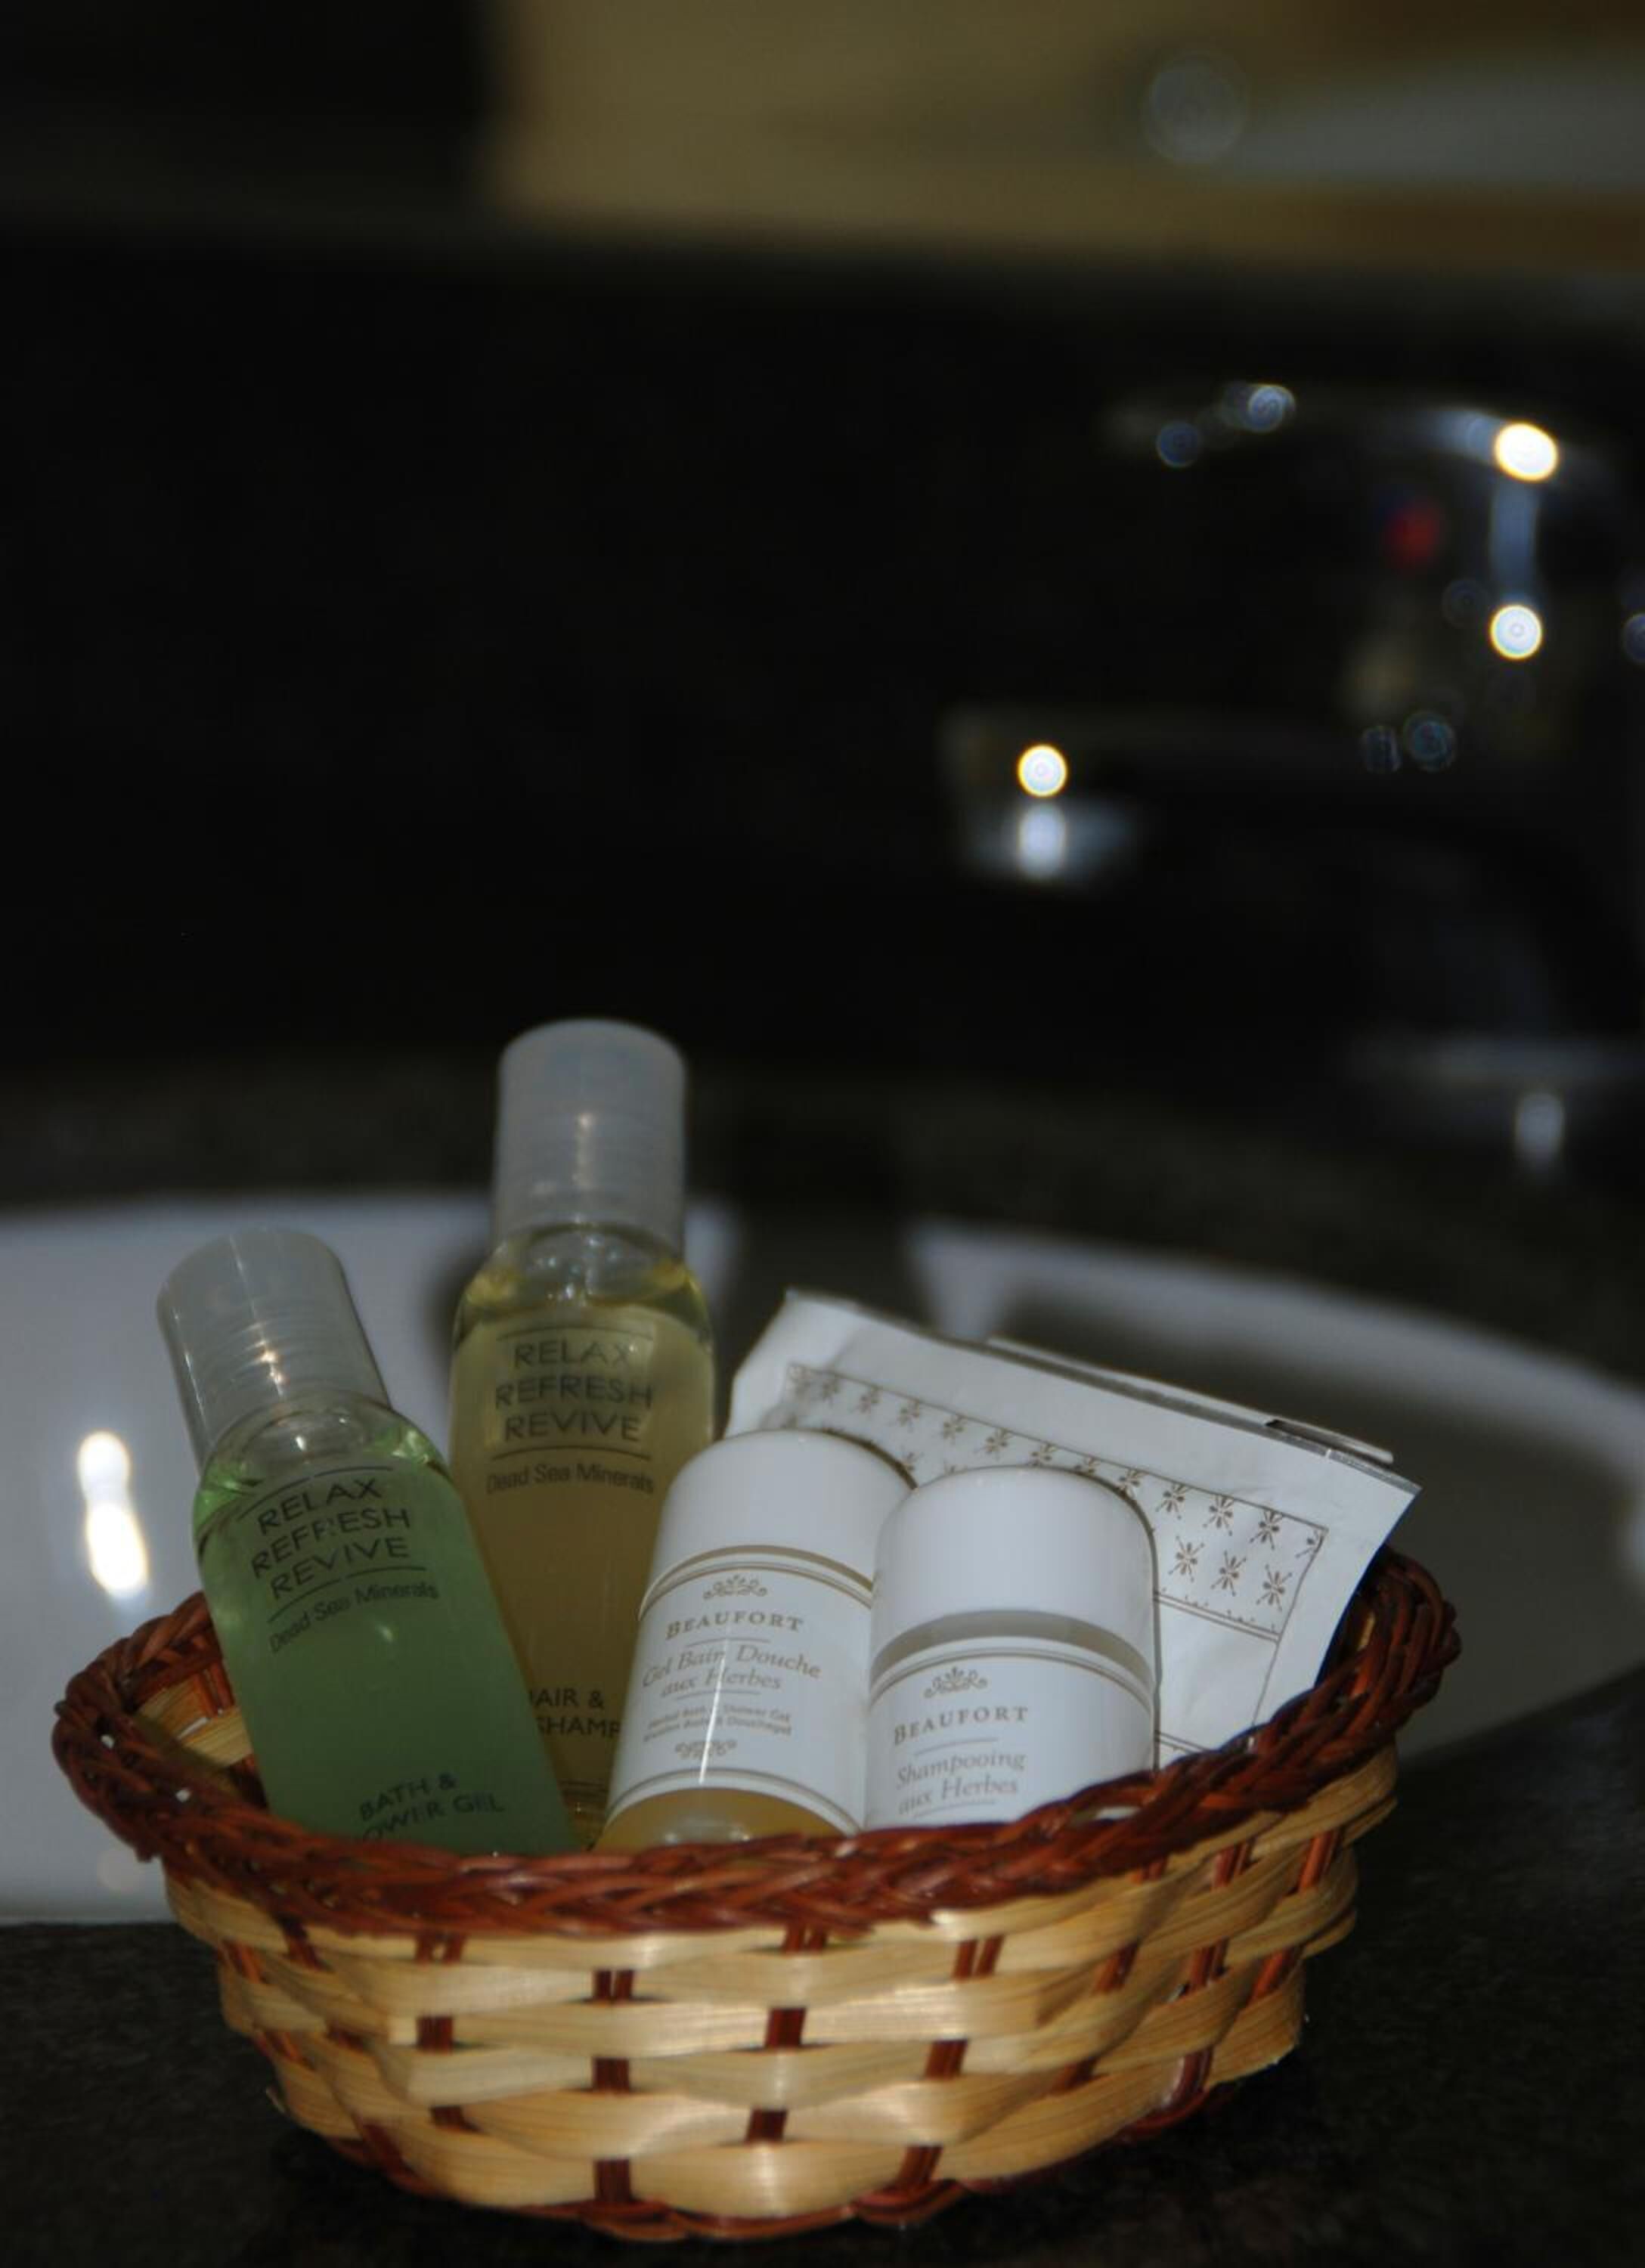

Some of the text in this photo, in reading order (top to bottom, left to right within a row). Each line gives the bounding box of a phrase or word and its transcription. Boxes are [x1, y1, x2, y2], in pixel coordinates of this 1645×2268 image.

[515, 1338, 629, 1369] RELAX
[496, 1374, 653, 1409] REFRESH
[505, 1408, 640, 1442] REVIVE
[486, 1463, 655, 1495] Dead Sea Minerals
[258, 1477, 383, 1535] RELAX
[250, 1507, 411, 1580] REFRESH
[270, 1538, 410, 1600] REVIVE
[269, 1582, 441, 1653] Dead Sea Minerals
[665, 1610, 804, 1641] BEAUFORT
[704, 1666, 783, 1690] Herbes
[736, 1644, 822, 1679] Douche
[587, 1690, 606, 1712] &
[894, 1706, 1028, 1746] BEAUFORT
[897, 1750, 1027, 1790] Shampooing
[940, 1774, 1019, 1800] Herbes
[360, 1771, 457, 1821] BATH &
[361, 1801, 446, 1842] OWER
